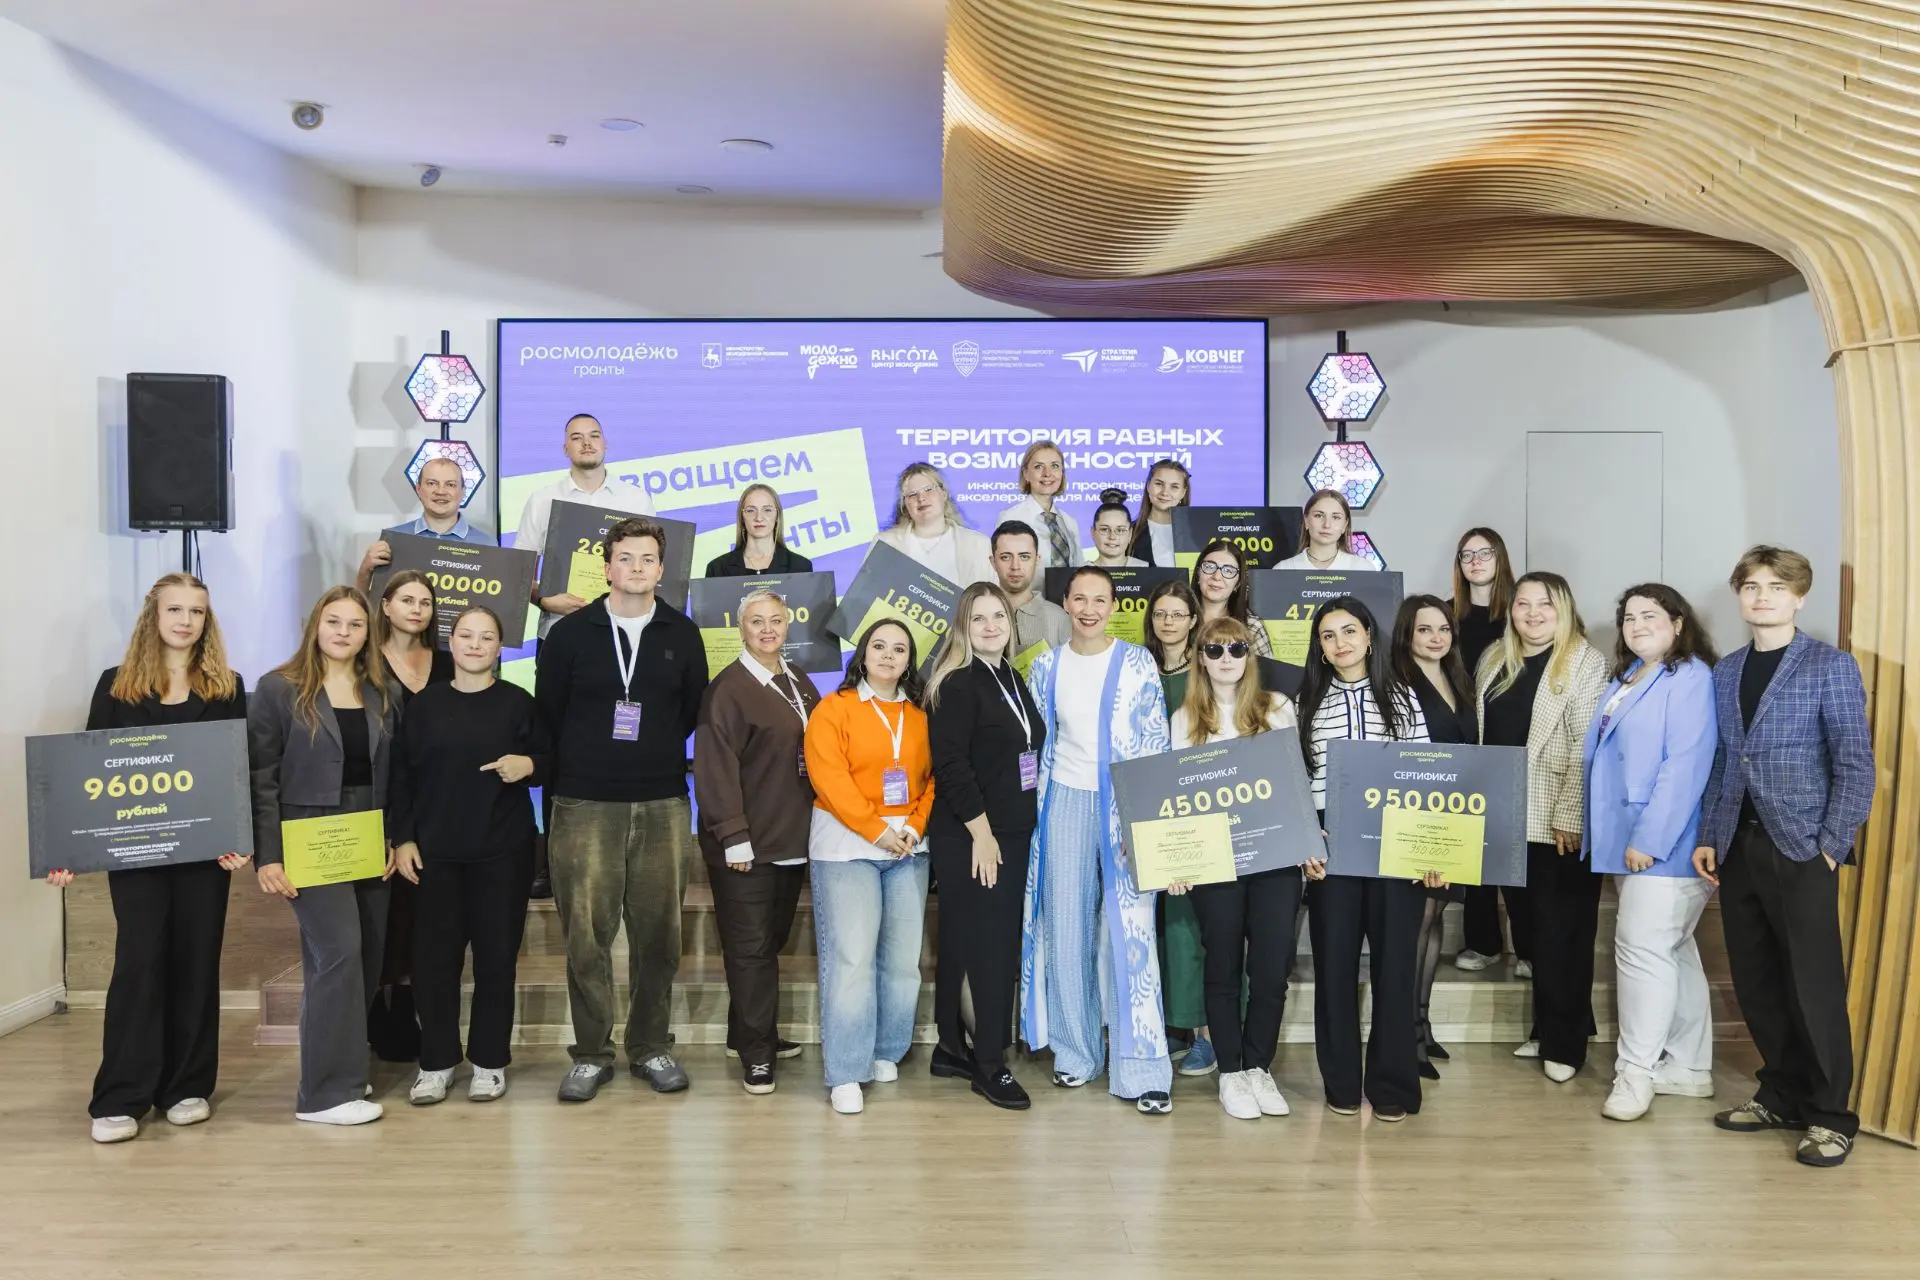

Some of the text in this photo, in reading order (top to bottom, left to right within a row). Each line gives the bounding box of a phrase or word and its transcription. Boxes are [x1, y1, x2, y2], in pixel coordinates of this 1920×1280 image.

[520, 342, 679, 367] росмолодёжь
[1186, 350, 1245, 363] КОВЧЕГ
[573, 365, 625, 378] гранты
[896, 428, 1224, 446] ТЕРРИТОРИЯ РАВНЫХ
[1072, 482, 1145, 492] проектны
[957, 493, 1027, 504] акселера
[1208, 537, 1274, 552] 000
[431, 560, 482, 571] СЕРТИФИКАТ
[908, 584, 951, 612] СЕРТИФИКАТ
[883, 588, 953, 639] 18800
[109, 733, 168, 746] росмолодёжь
[104, 753, 176, 768] СЕРТИФИКАТ
[1178, 766, 1239, 786] СЕРТИФИКАТ
[1393, 770, 1458, 782] СЕРТИФИКАТ
[84, 769, 194, 801] 96000
[116, 803, 168, 820] рублей
